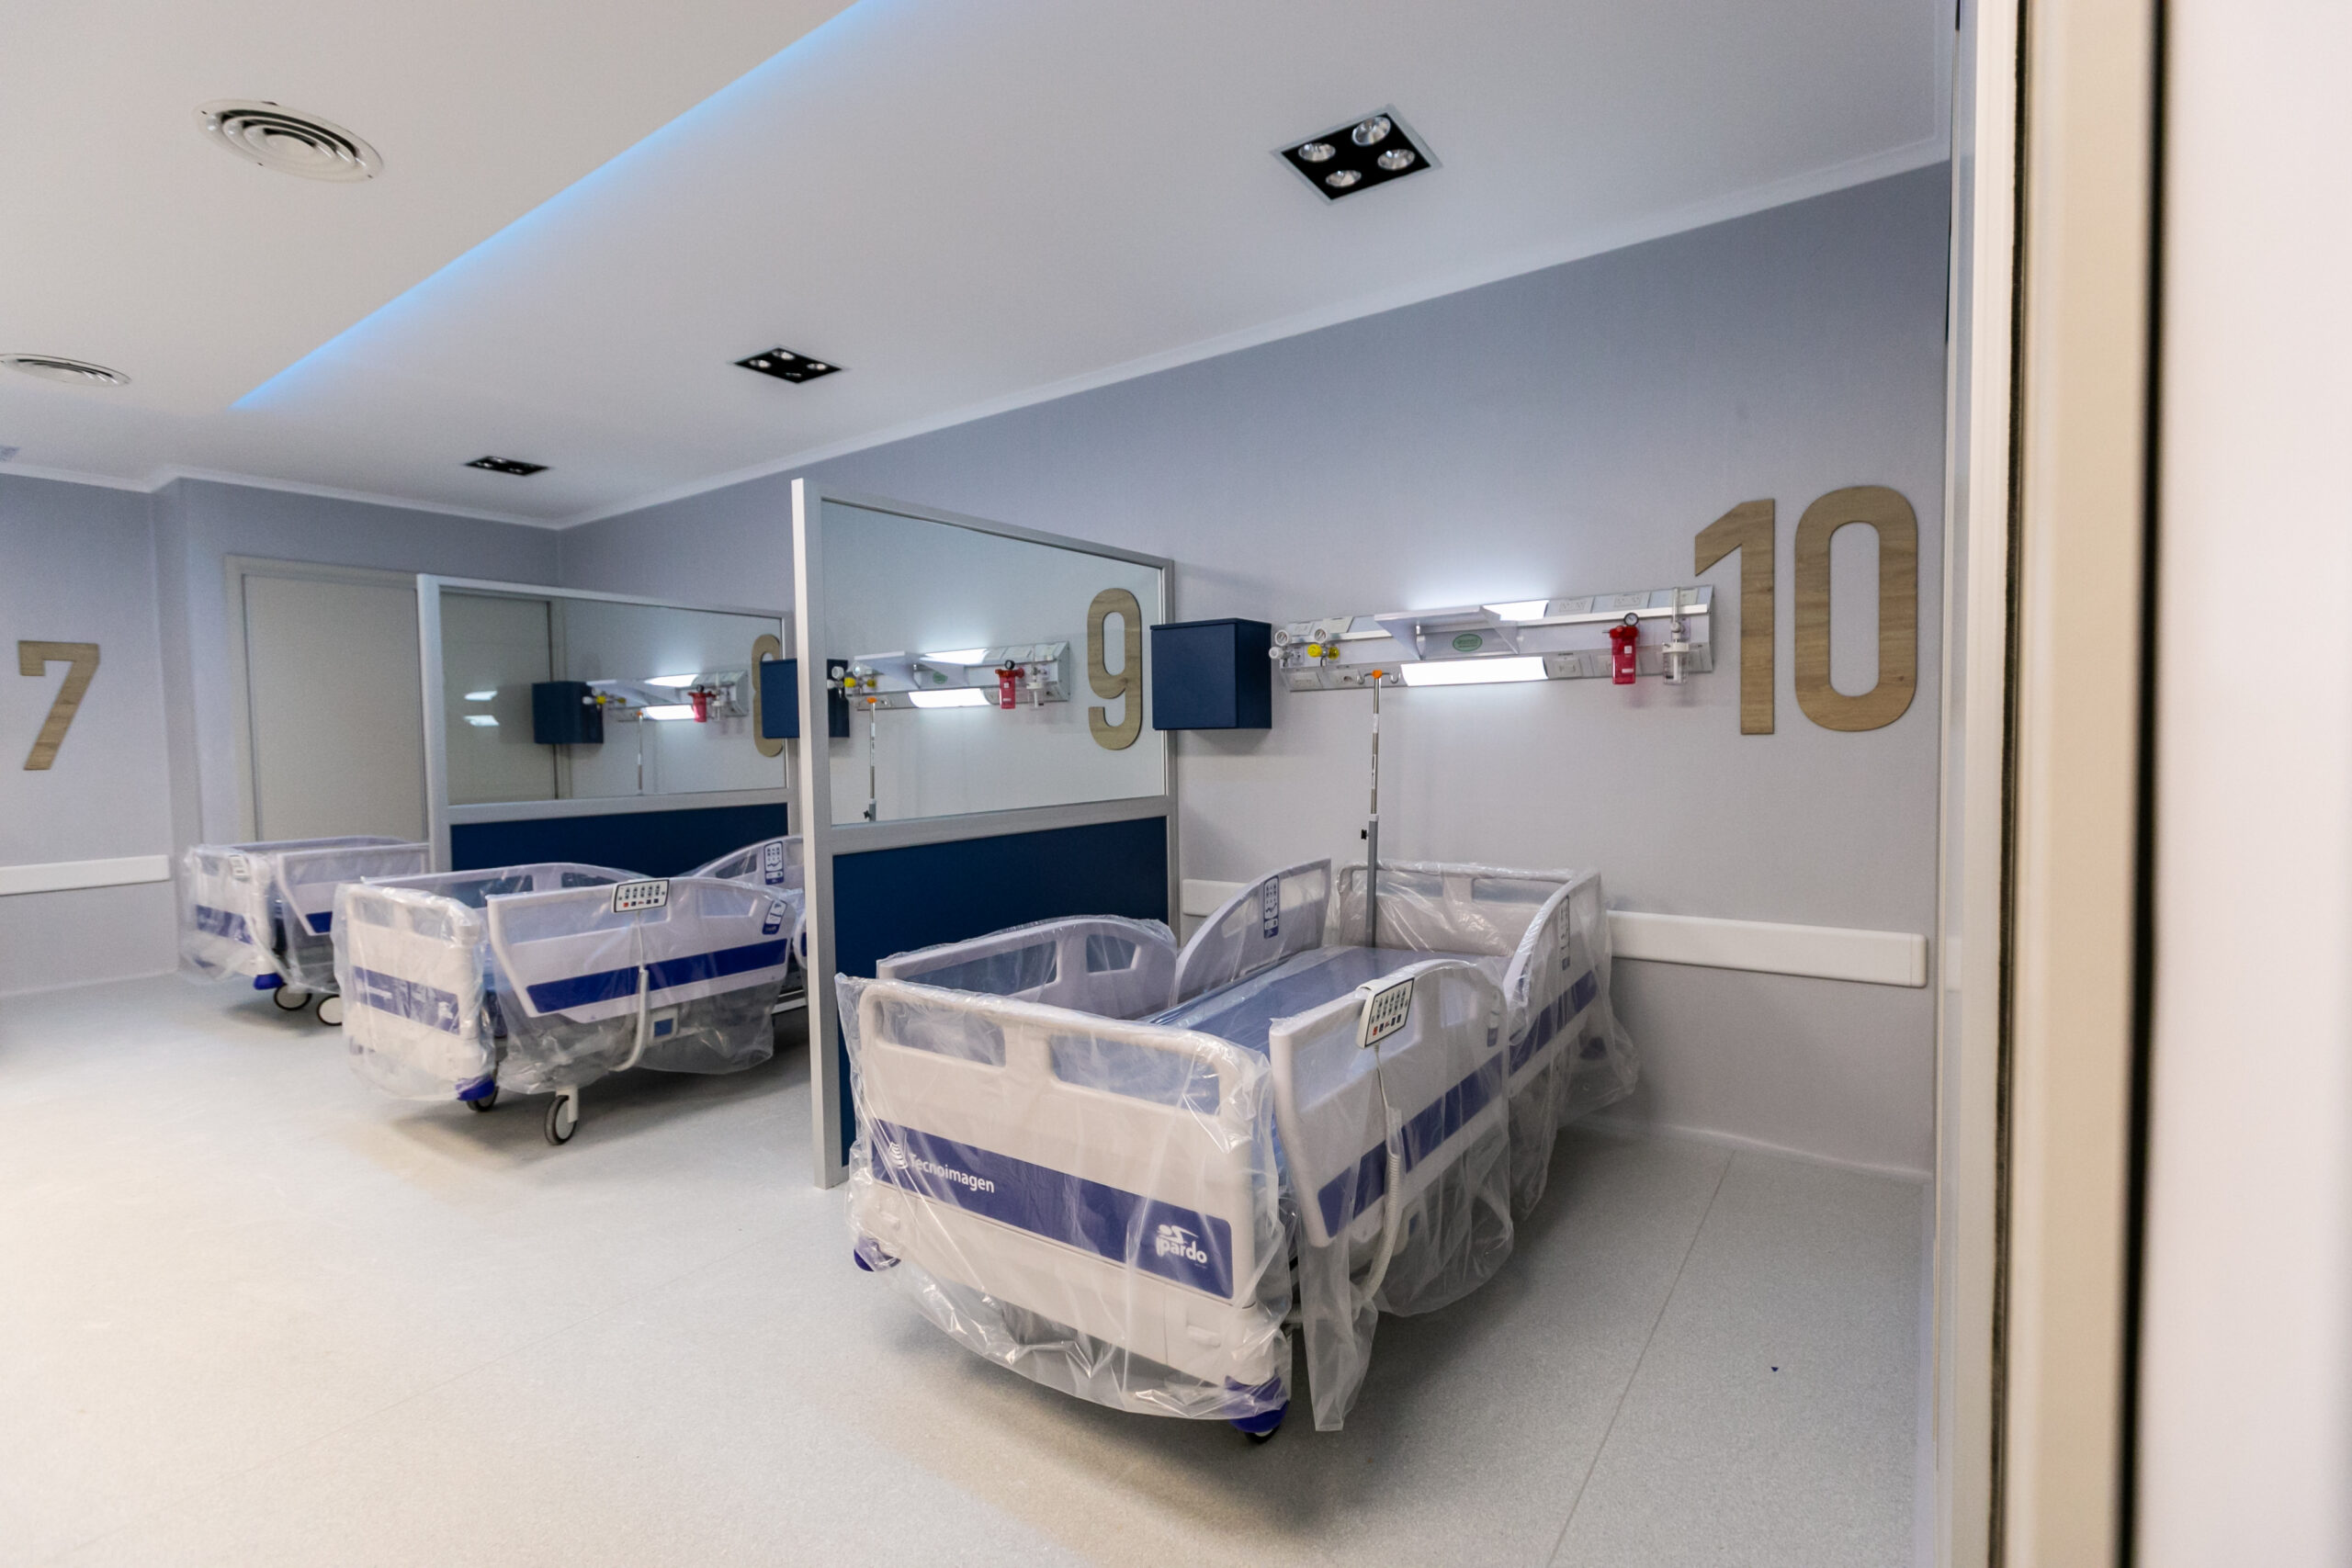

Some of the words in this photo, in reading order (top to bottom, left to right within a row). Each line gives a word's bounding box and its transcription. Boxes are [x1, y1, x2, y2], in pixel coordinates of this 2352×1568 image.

[1087, 587, 1143, 750] 9
[1694, 485, 1917, 735] 10
[17, 639, 101, 771] 7
[909, 1152, 995, 1193] Tecnoimagen
[1156, 1235, 1208, 1264] pardo
